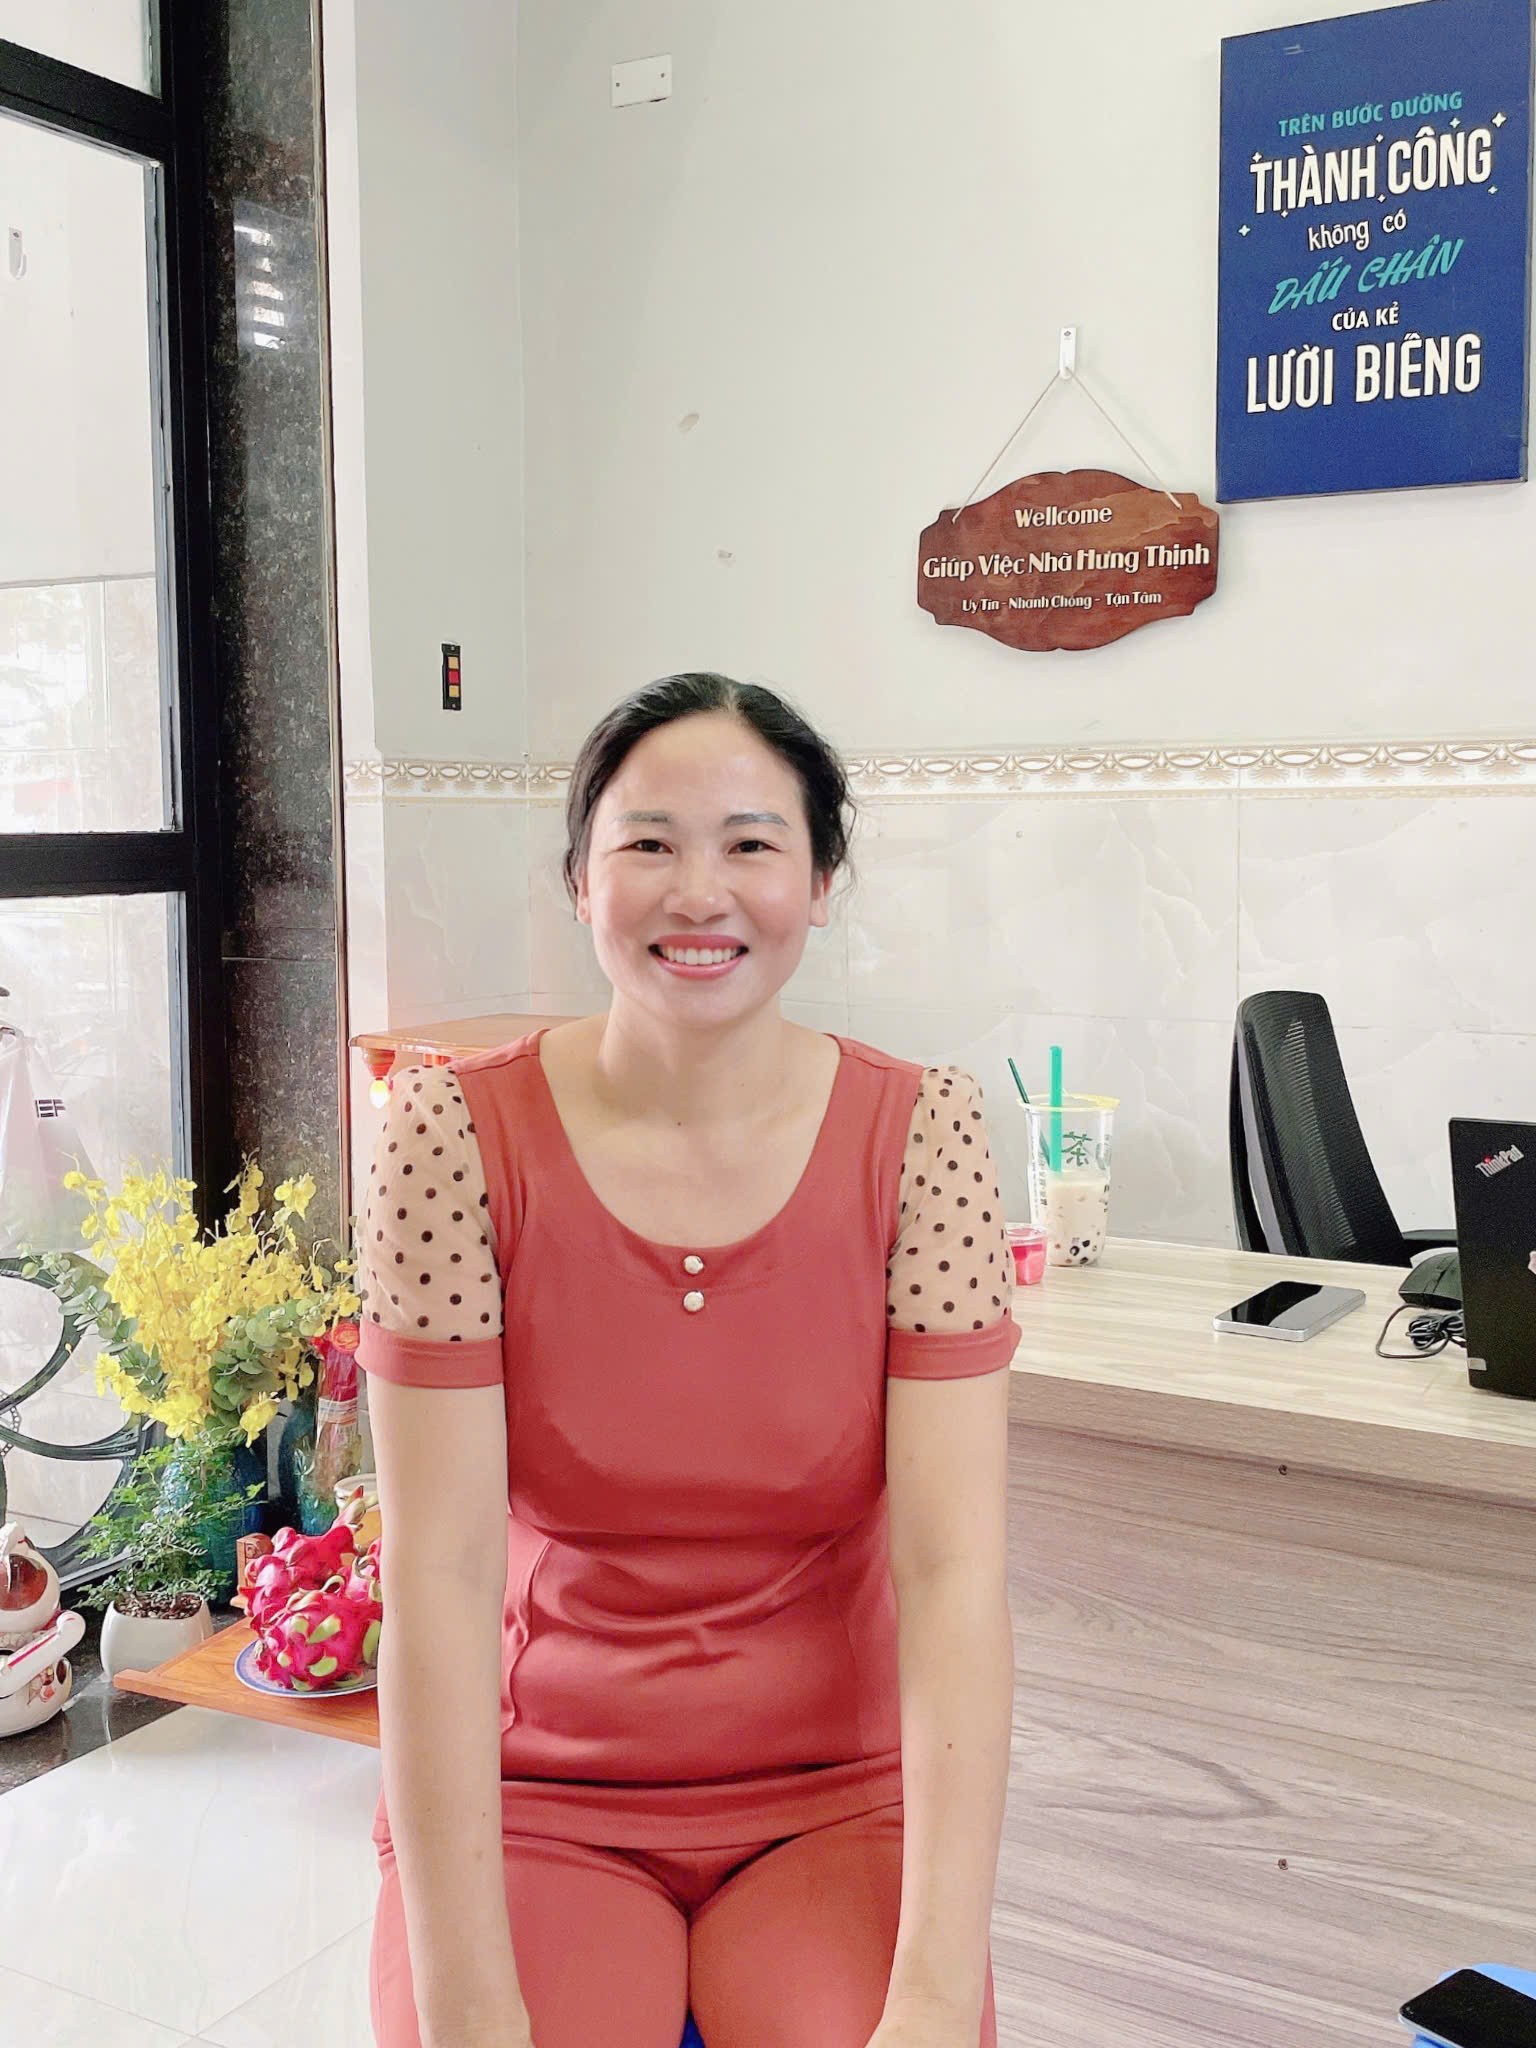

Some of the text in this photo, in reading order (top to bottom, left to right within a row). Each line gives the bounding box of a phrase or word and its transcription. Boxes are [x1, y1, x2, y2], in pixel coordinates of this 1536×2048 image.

[1278, 91, 1463, 137] TRÊN BƯỚC ĐƯỜNG
[1250, 126, 1492, 214] THÀNH CÔNG
[1308, 209, 1407, 252] không có
[1267, 234, 1465, 314] DẤU CHÂN
[1332, 301, 1399, 331] CỦA KẺ
[1247, 332, 1481, 414] LƯỜI BIẾNG
[1014, 506, 1113, 528] Wellcome
[923, 556, 975, 581] Giúp
[978, 554, 1025, 578] Việc
[1076, 549, 1140, 573] Hưng
[1144, 543, 1210, 570] Thịnh
[962, 599, 979, 613] Uy
[1009, 596, 1049, 609] Nhanh
[1105, 592, 1129, 607] Tận
[1132, 591, 1162, 604] Tâm
[1475, 1144, 1525, 1178] ThinkPad
